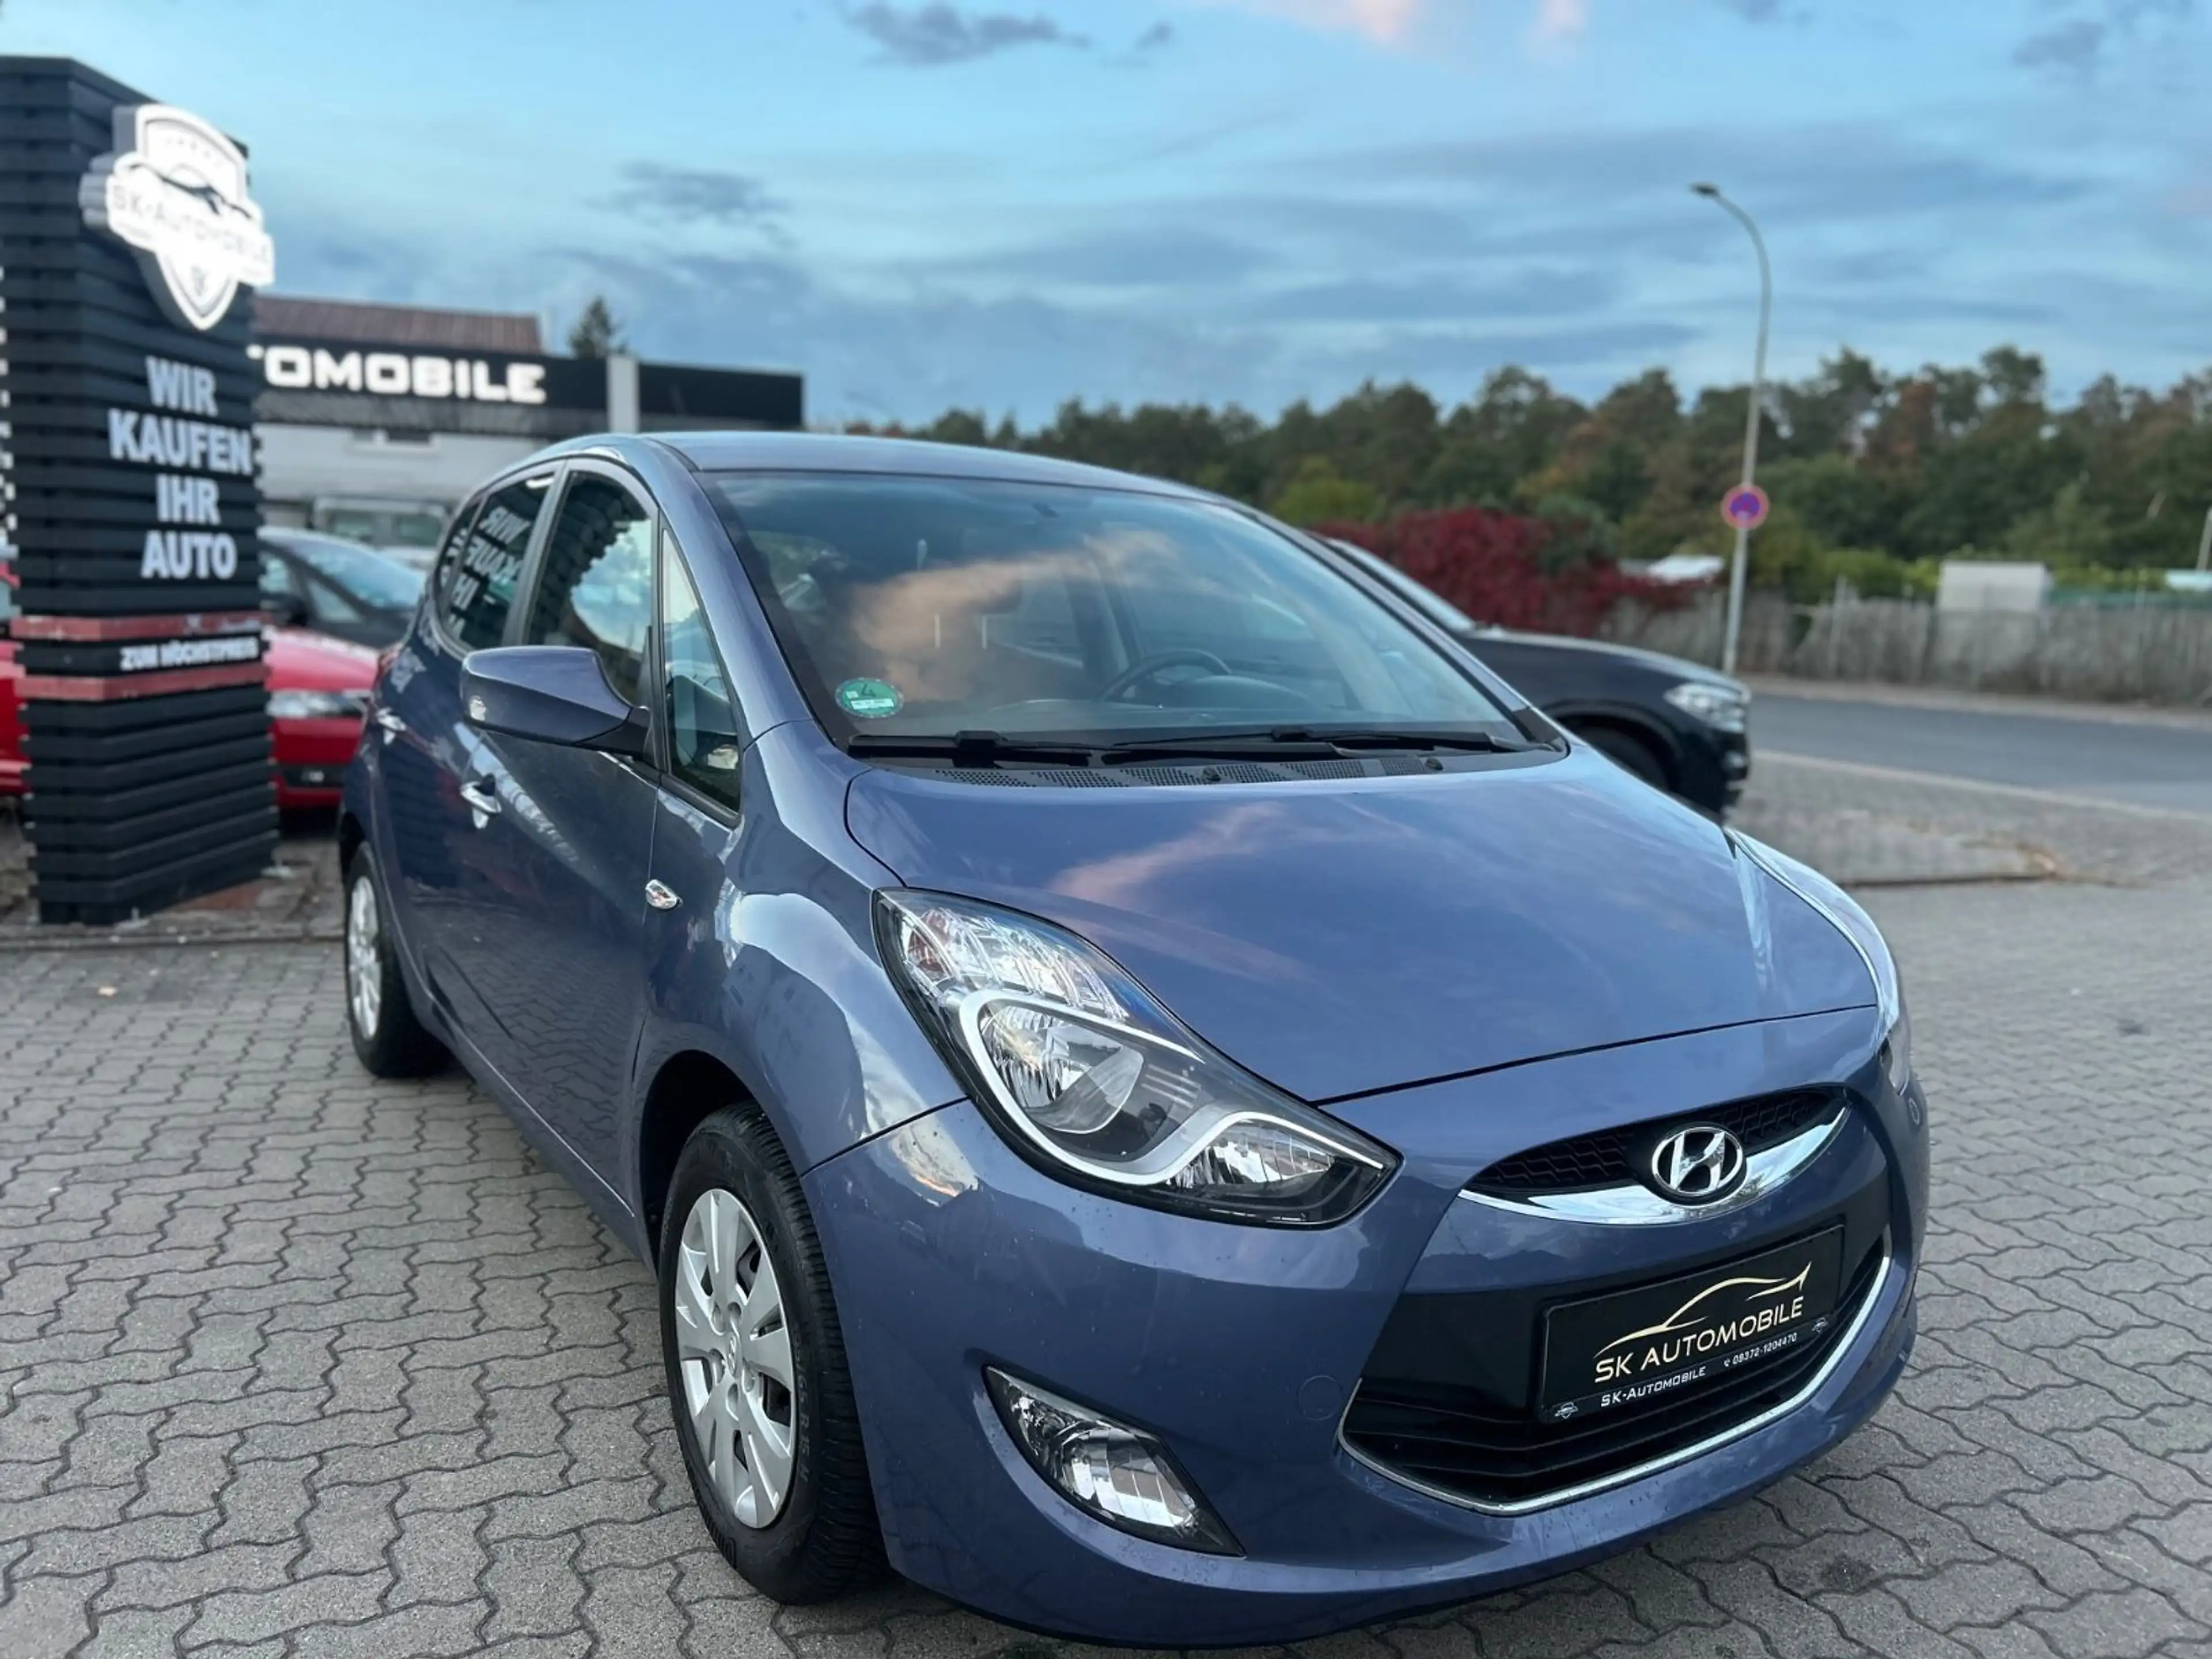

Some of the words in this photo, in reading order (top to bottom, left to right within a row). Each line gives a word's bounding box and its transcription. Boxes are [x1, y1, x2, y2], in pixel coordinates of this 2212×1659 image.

[145, 355, 218, 416] WIR
[246, 344, 546, 404] OMOBILE
[108, 408, 253, 476] KAUFEN
[156, 474, 221, 525] IHR
[141, 530, 237, 578] AUTO
[1594, 1353, 1634, 1382] SK
[1640, 1295, 1804, 1370] AUTOMOBILE
[1600, 1366, 1706, 1407] SK-AUTOMOBILE
